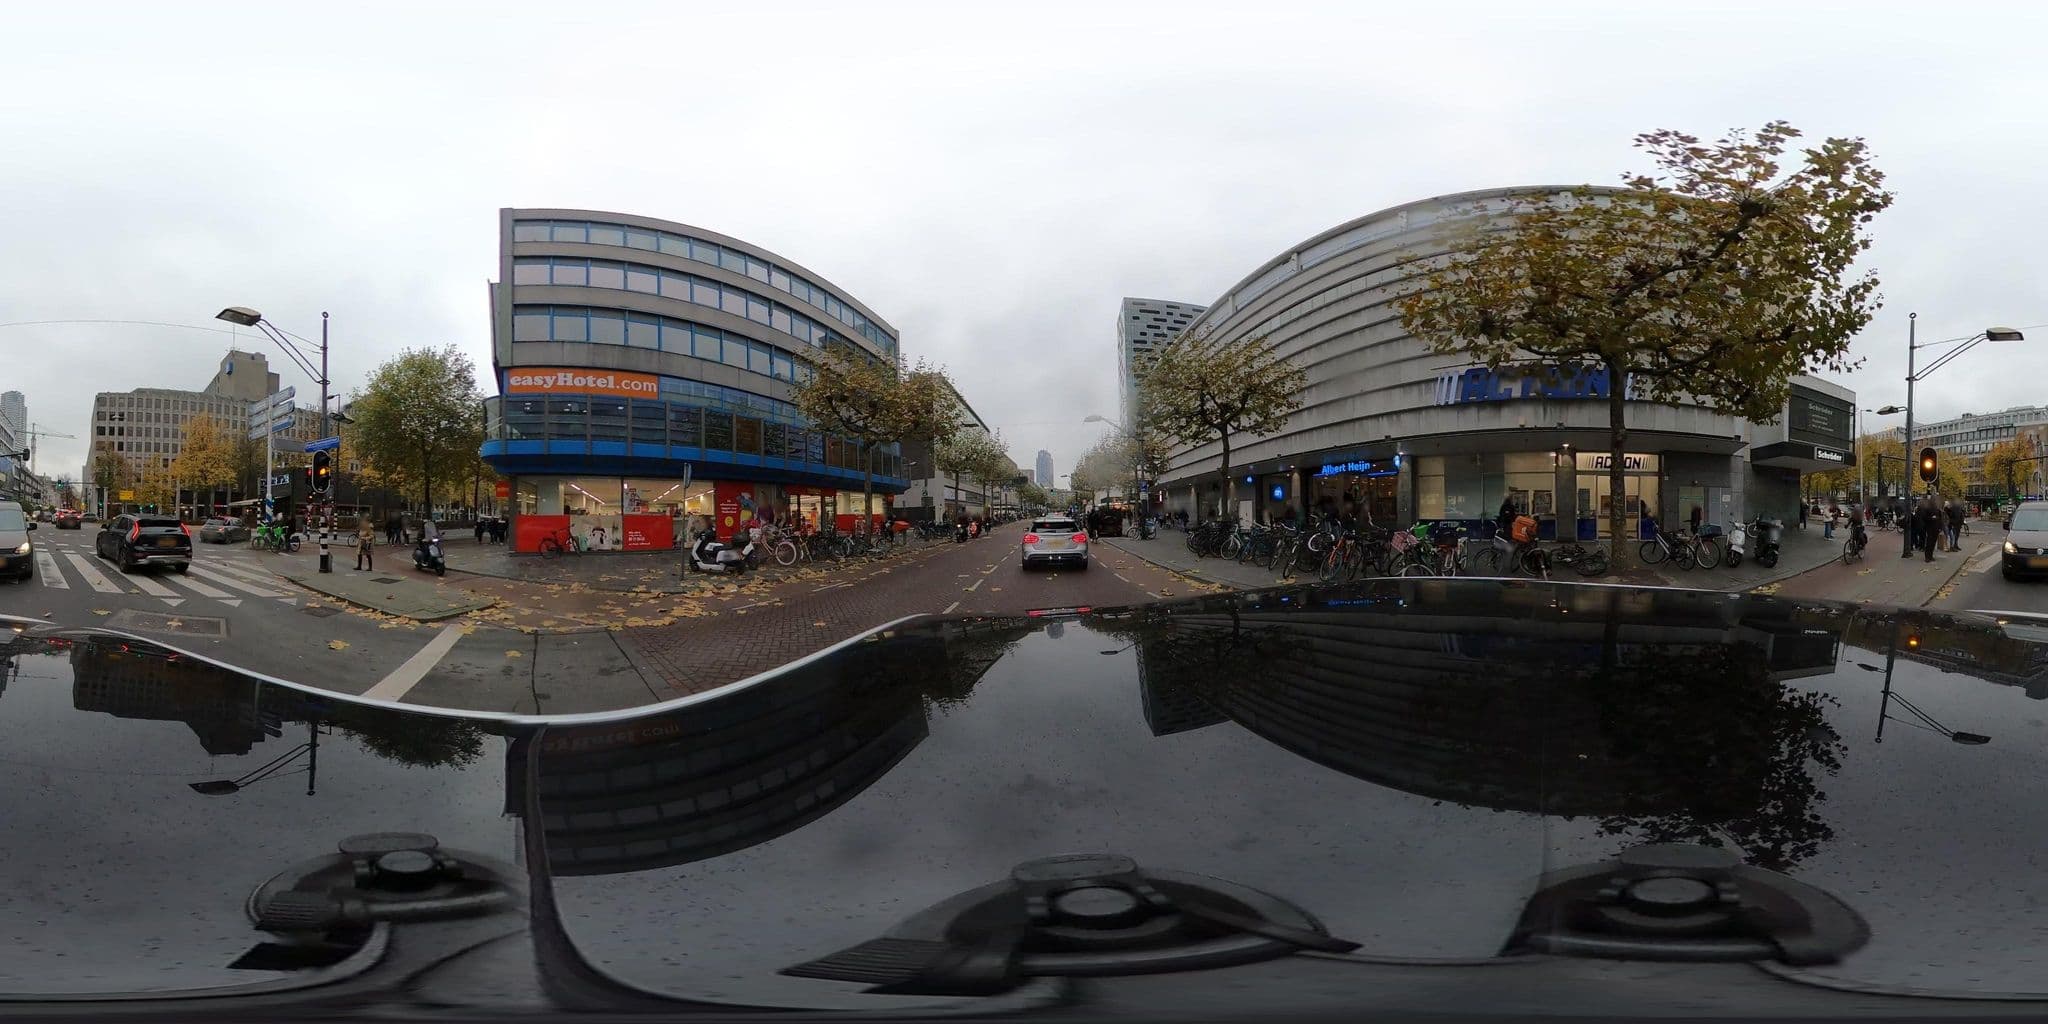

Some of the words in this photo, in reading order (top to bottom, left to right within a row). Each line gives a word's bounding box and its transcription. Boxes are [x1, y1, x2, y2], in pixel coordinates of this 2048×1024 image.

[510, 372, 657, 393] easyHotel.com
[1321, 463, 1346, 475] Albert
[1348, 460, 1370, 473] Heijn
[1595, 456, 1641, 469] ACON
